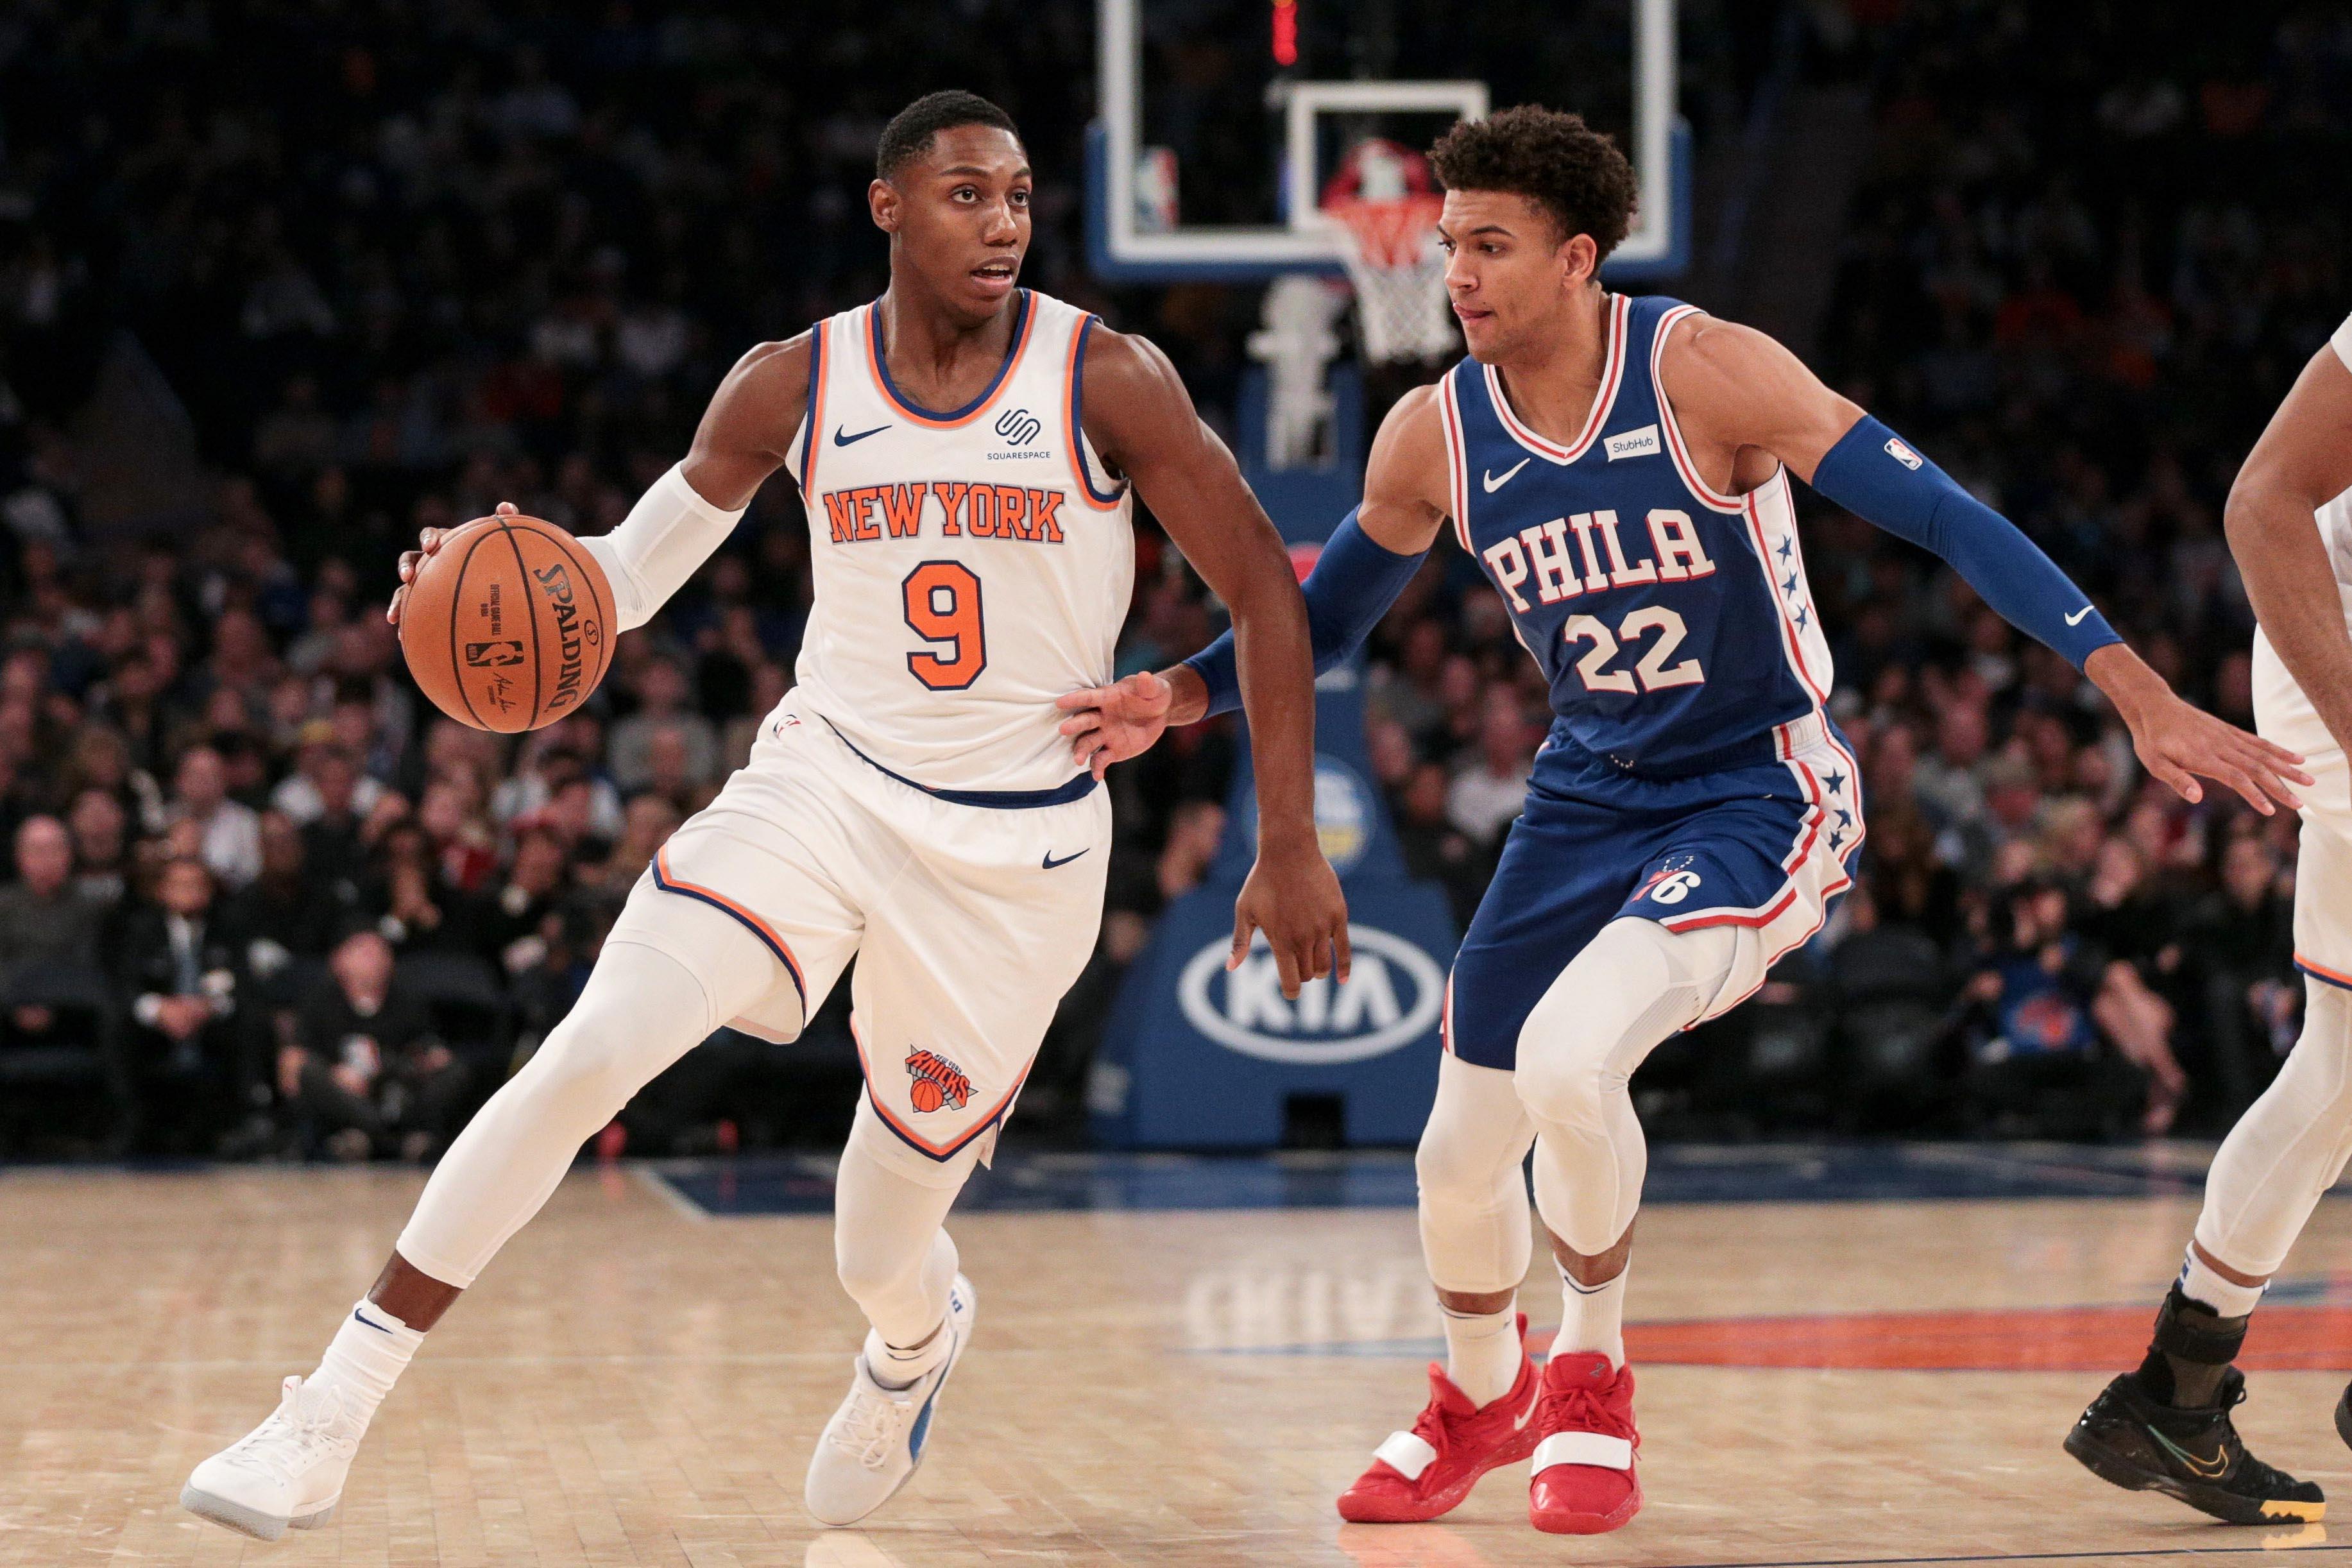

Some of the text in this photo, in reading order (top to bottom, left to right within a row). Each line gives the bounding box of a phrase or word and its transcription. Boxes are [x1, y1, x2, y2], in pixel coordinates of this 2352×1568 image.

[987, 451, 1051, 461] SQUARESPACE
[1612, 436, 1653, 453] StubHub
[822, 480, 1066, 545] NEW YORK
[1483, 509, 1716, 614] PHILA
[491, 607, 501, 622] GAME
[533, 563, 582, 708] SPALDING
[901, 560, 987, 691] 9
[1564, 605, 1705, 695] 22
[1225, 951, 1401, 1032] KIA
[905, 1050, 971, 1107] KNICKS
[934, 1054, 962, 1075] NEW YORK
